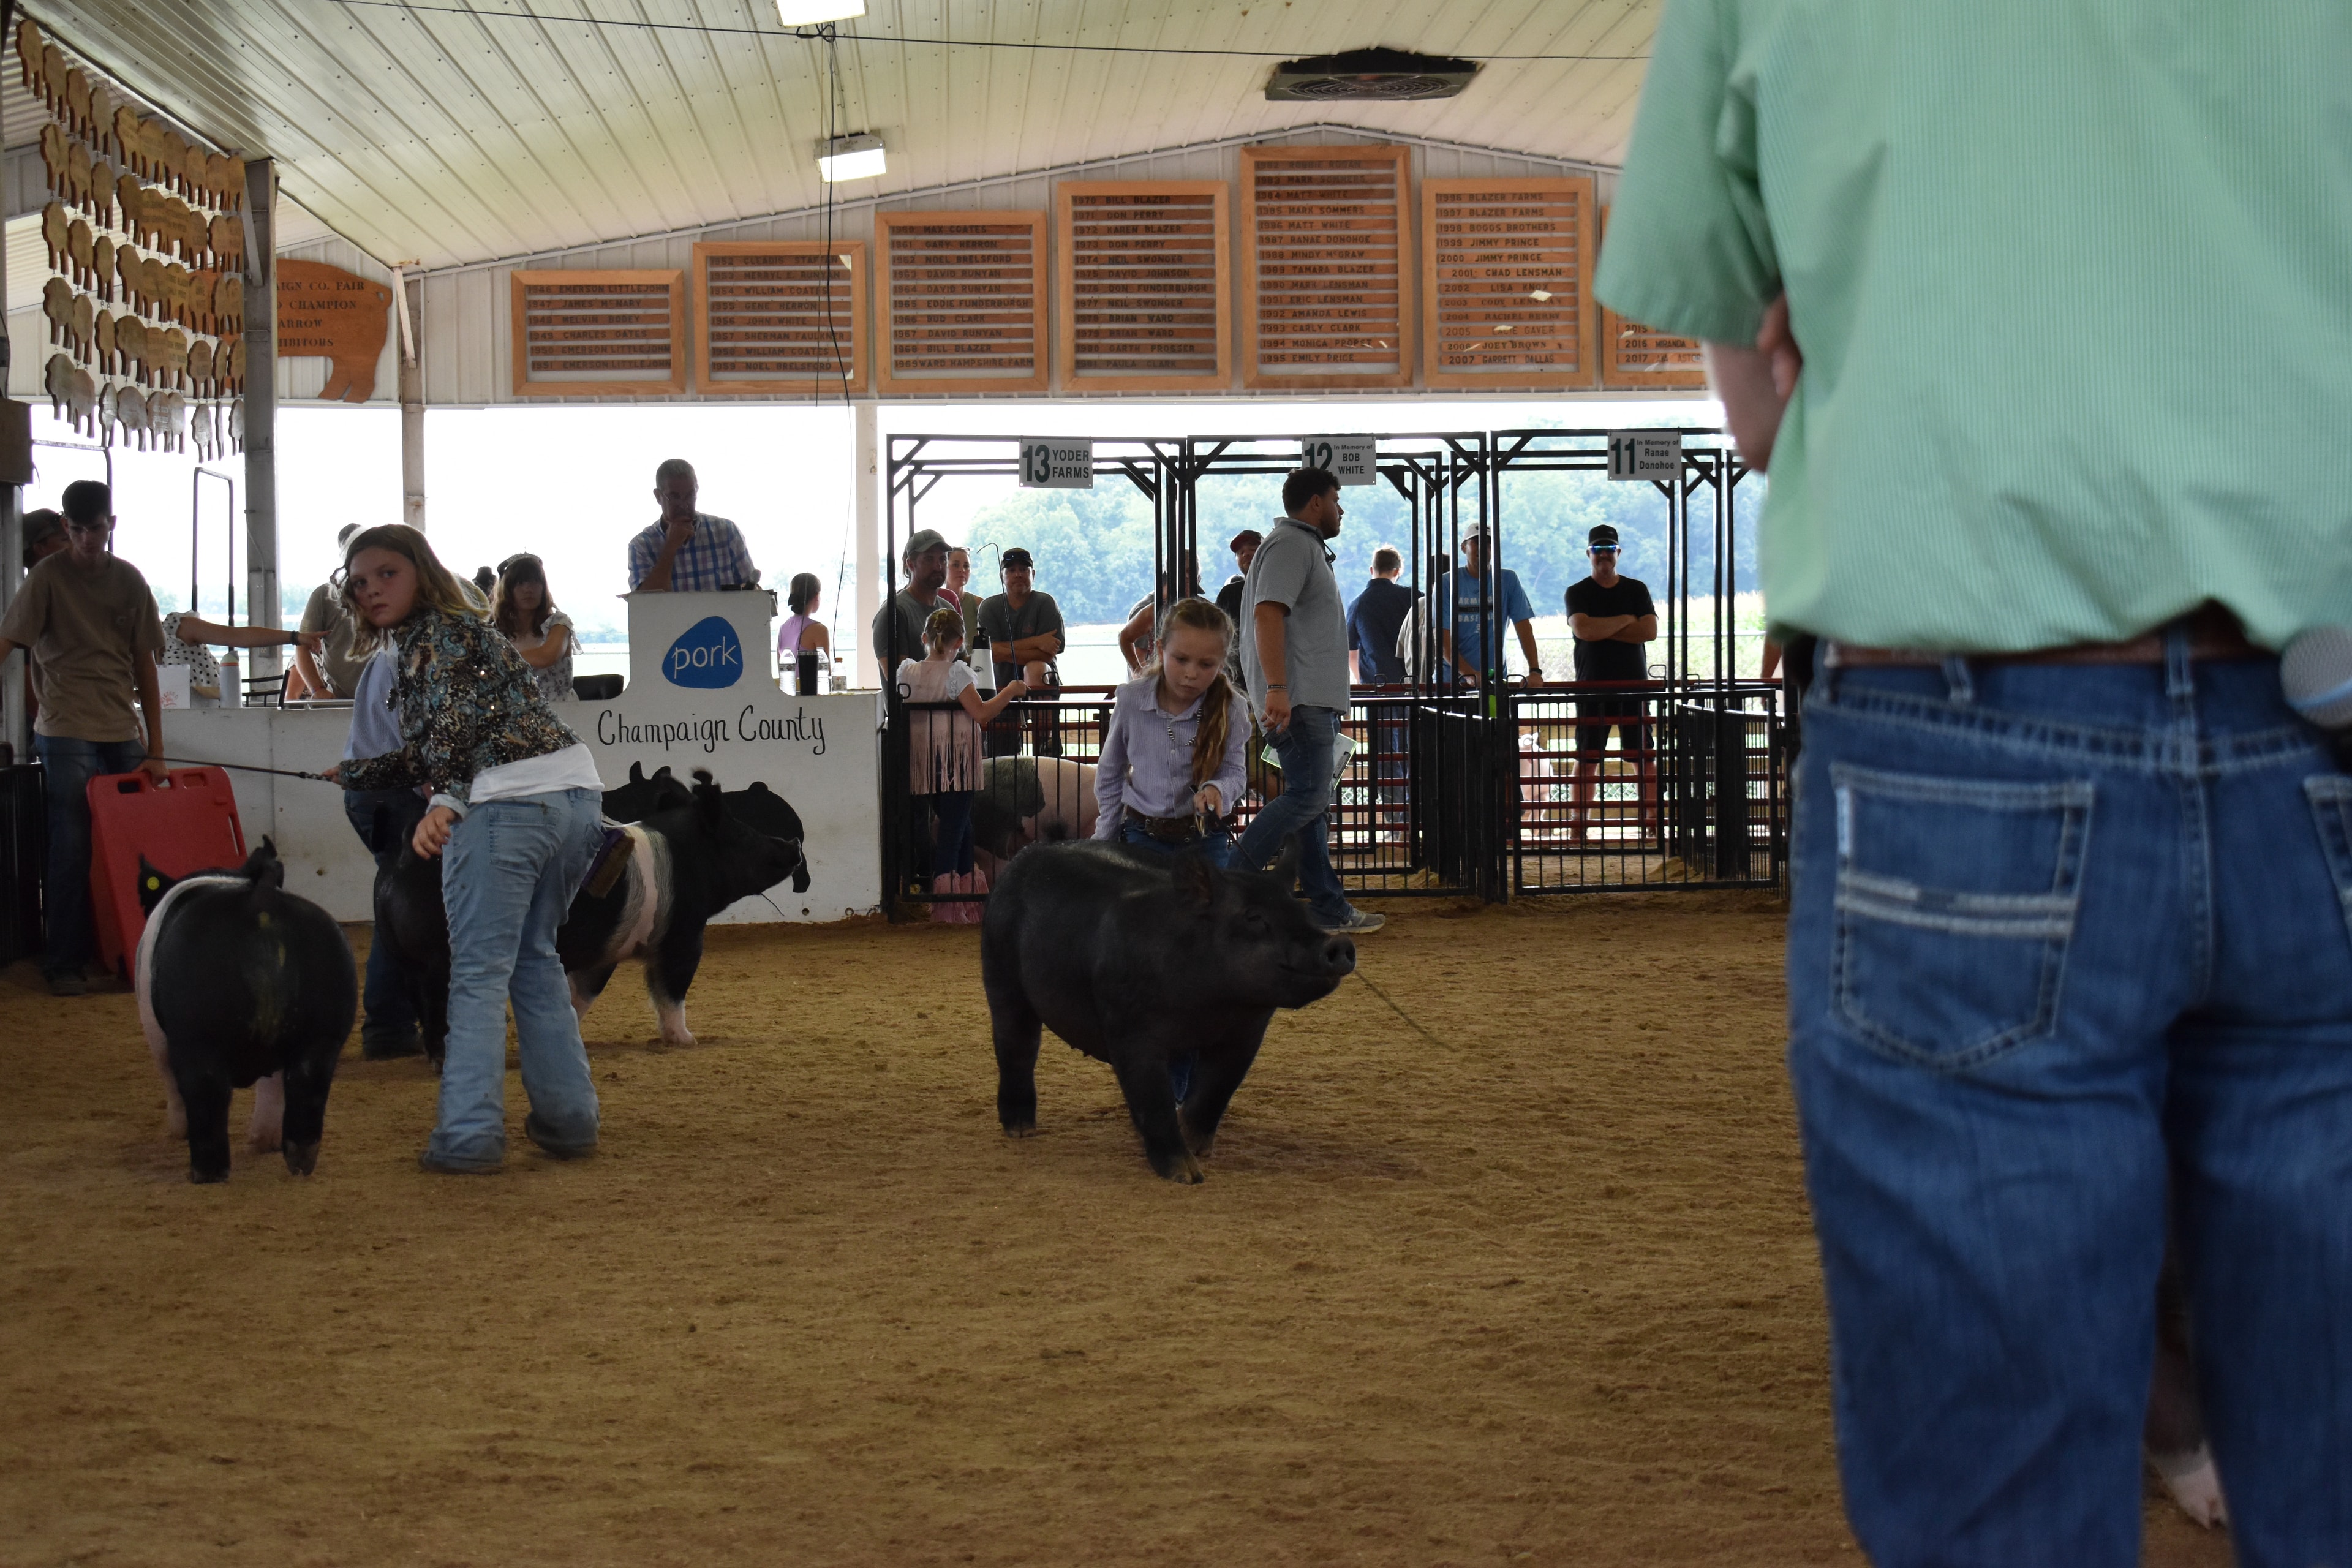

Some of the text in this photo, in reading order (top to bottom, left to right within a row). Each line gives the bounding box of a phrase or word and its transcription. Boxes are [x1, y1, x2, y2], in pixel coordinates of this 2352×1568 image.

[956, 255, 1011, 263] BRELSFORD
[337, 281, 364, 290] FAIR
[290, 300, 356, 309] CHAMPION
[959, 299, 1028, 307] FUNDERBURGH
[279, 319, 322, 328] ARROW
[1524, 326, 1555, 334] GAVER
[1625, 339, 1648, 348] 2016
[1656, 339, 1686, 348] MIRANDA
[1449, 356, 1474, 364] 2007
[1483, 355, 1516, 364] GARRETT
[1625, 353, 1648, 363] 2017
[563, 360, 608, 369] EMERSON
[1052, 450, 1089, 461] YODER
[1305, 442, 1332, 470] 12
[1343, 453, 1360, 462] BOB
[1610, 438, 1635, 474] 11
[1022, 445, 1050, 483] 13
[1052, 467, 1089, 478] FARMS
[671, 636, 738, 679] pork
[598, 704, 826, 755] Champaign County
